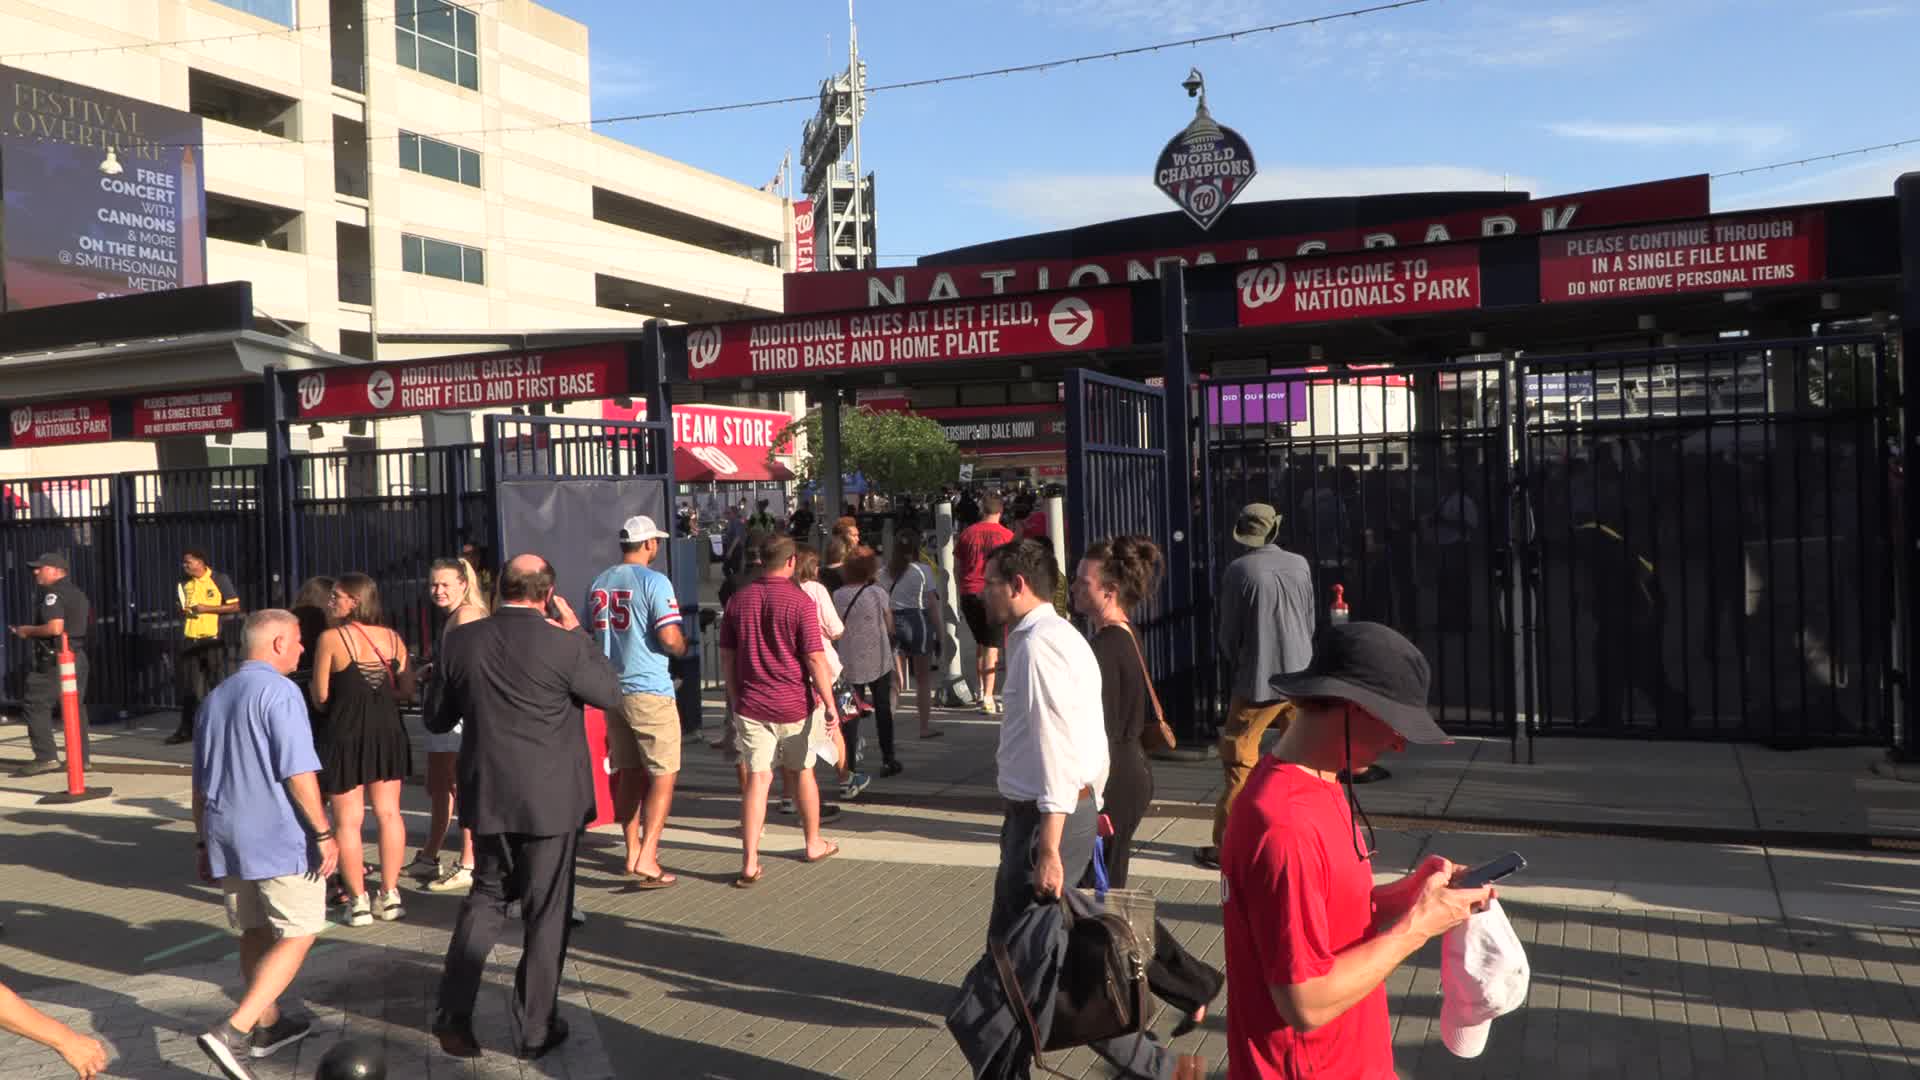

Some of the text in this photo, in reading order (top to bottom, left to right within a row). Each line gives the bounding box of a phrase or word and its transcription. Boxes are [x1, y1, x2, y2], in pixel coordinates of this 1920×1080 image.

[14, 83, 142, 134] FESTIVAL
[1172, 147, 1235, 166] WORLD
[1190, 143, 1215, 153] 2019
[137, 168, 175, 188] FREE
[1159, 160, 1250, 185] CHAMPIONS
[100, 178, 175, 204] CONCERT
[98, 208, 176, 233] CANNONS
[141, 202, 175, 218] WITH
[79, 236, 177, 264] ON THE MALL
[128, 230, 176, 248] & MORE
[1567, 220, 1793, 256] PLEASE CONTINUE THROUGH
[58, 250, 177, 279] @ SMITHSONIAN
[1592, 243, 1767, 273] IN A SINGLE FILE LINE
[128, 276, 177, 292] METRO
[1292, 259, 1428, 289] WELCOME TO
[1568, 264, 1795, 296] DO NOT REMOVE PERSONAL ITEMS
[1295, 277, 1470, 312] NATIONALS PARK
[750, 301, 1039, 348] ADDITIONAL GATES AT LEFT FIELD,
[750, 330, 1000, 371] THIRD BASE AND HOME PLATE
[401, 355, 543, 387] ADDITIONAL GATES AT
[401, 372, 596, 407] RIGHT FIELD AND FIRST BASE
[34, 407, 90, 424] WELCOME TO
[162, 409, 167, 420] A
[168, 407, 191, 419] SINGLE
[192, 405, 206, 417] FILE
[207, 404, 223, 416] LINE
[35, 419, 107, 439] NATIONALS PARK
[672, 412, 717, 444] TEAM
[723, 416, 773, 447] STORE
[979, 424, 990, 439] ON
[991, 422, 1011, 439] SALE
[1011, 421, 1035, 438] NOW!
[590, 588, 633, 632] 25
